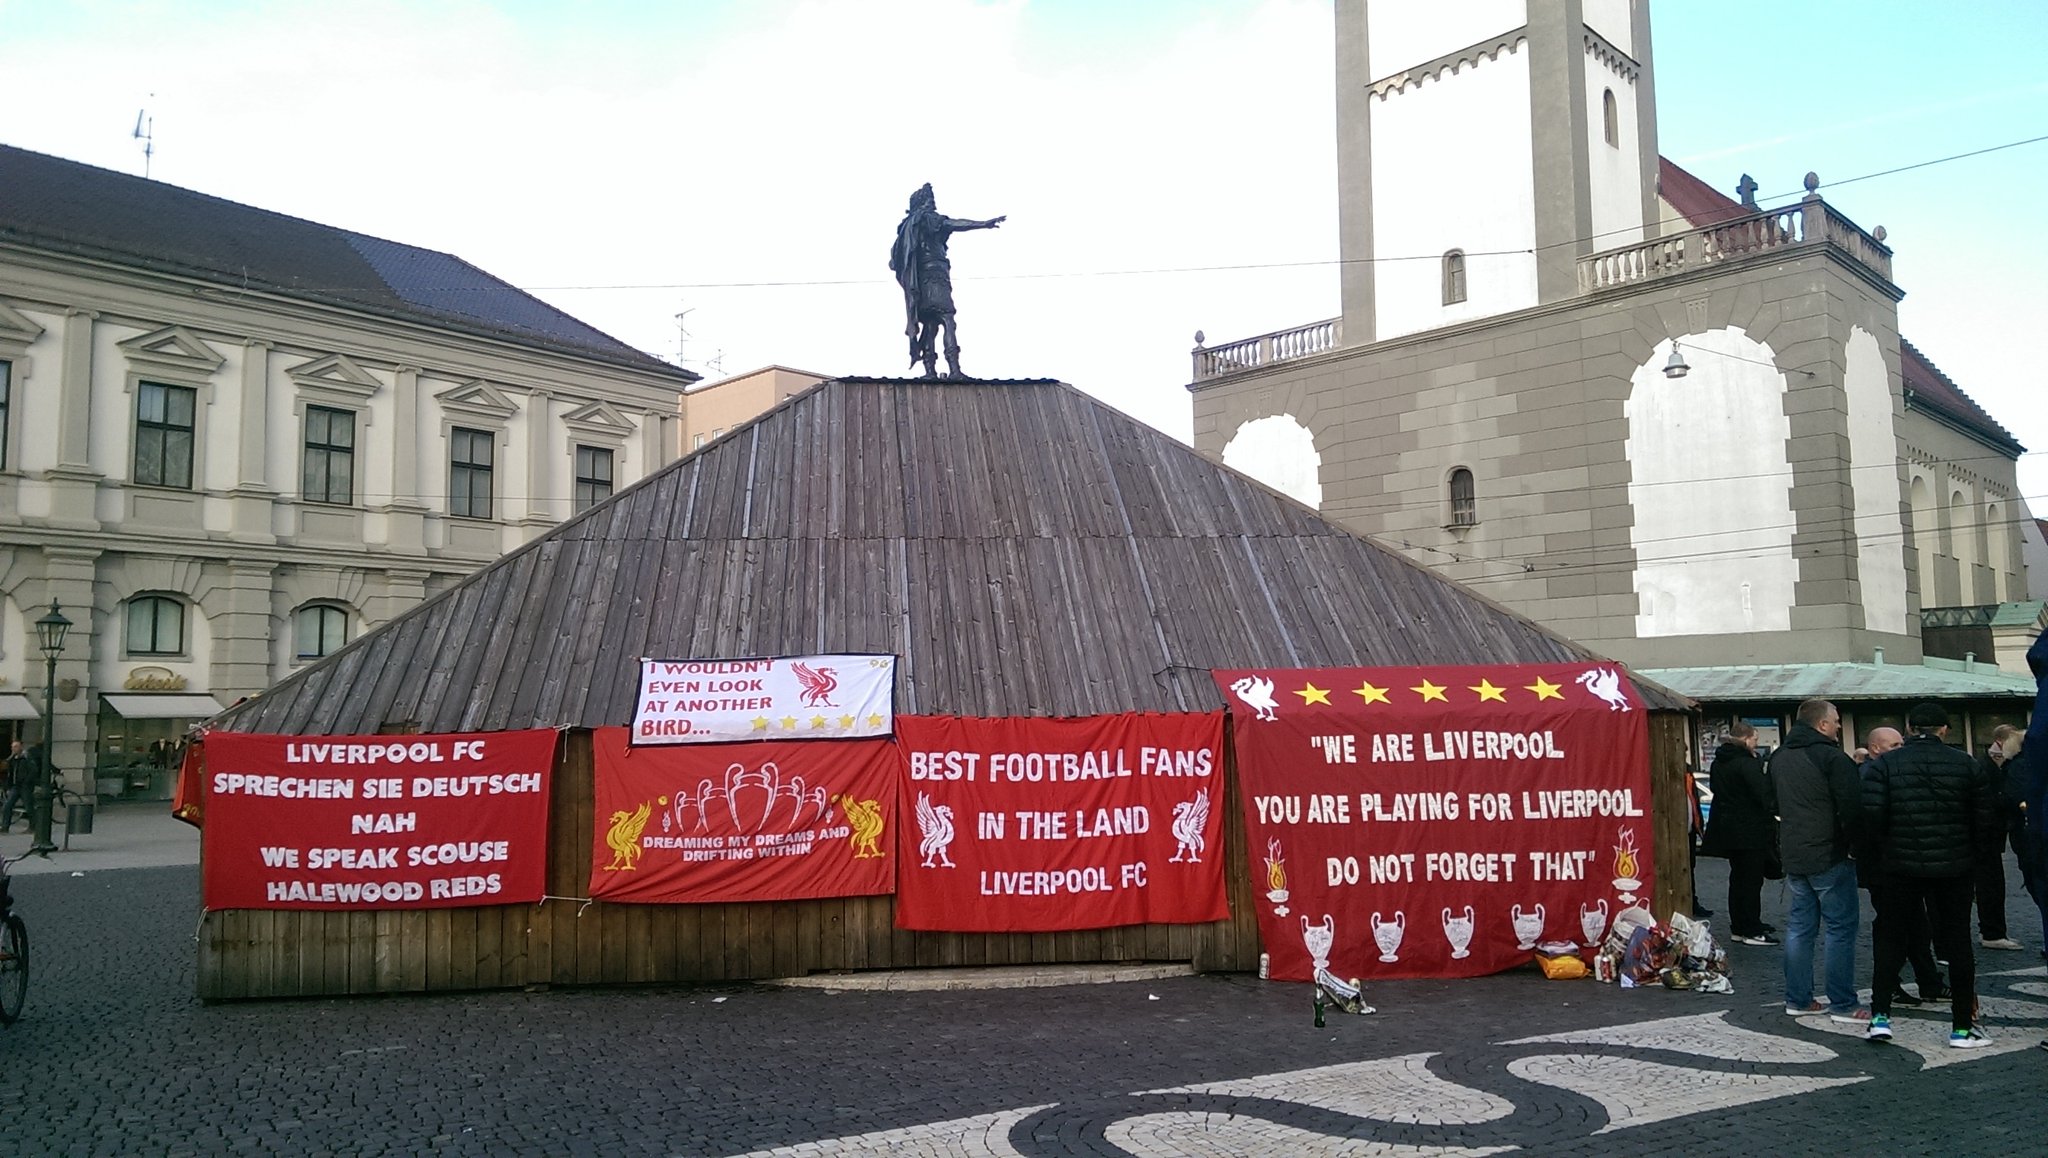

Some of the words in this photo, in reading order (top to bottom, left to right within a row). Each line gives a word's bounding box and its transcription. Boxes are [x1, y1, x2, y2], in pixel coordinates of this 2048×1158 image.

[650, 663, 656, 674] I
[664, 660, 775, 674] WOULDN'T
[648, 681, 700, 694] EVEN
[708, 679, 763, 692] LOOK
[644, 700, 669, 713] AT
[674, 696, 772, 712] ANOTHER
[287, 743, 444, 764] LIVERPOOL
[453, 741, 485, 761] FC
[1371, 733, 1414, 762] ARE
[1424, 730, 1565, 761] LIVERPOOL
[911, 752, 980, 782] BEST
[989, 749, 1131, 782] FOOTBALL
[1140, 747, 1212, 777] FANS
[214, 773, 354, 799] SPRECHEN
[362, 778, 403, 798] SIE
[412, 773, 541, 797] DEUTSCH
[1254, 795, 1300, 825] YOU
[1307, 794, 1350, 824] ARE
[1360, 791, 1459, 822] PLAYING
[1468, 792, 1514, 821] FOR
[1522, 789, 1643, 819] LIVERPOOL
[352, 812, 416, 834] NAH
[978, 812, 1004, 839] IN
[1016, 811, 1066, 839] THE
[1076, 806, 1149, 838] LAND
[643, 836, 722, 849] DREAMING
[728, 835, 750, 847] MY
[755, 832, 815, 846] DREAMS
[818, 826, 849, 840] AND
[261, 847, 299, 868] WE
[308, 848, 398, 869] SPEAK
[408, 841, 508, 866] SCOUSE
[683, 848, 753, 862] DRIFTING
[758, 843, 811, 858] WITHIN
[980, 866, 1112, 895] LIVERPOOL
[1121, 861, 1147, 888] FC
[1327, 856, 1359, 886] DO
[1370, 854, 1415, 884] NOT
[1426, 852, 1516, 882] FORGET
[267, 882, 423, 902] HALEWOOD
[430, 874, 501, 898] REDS
